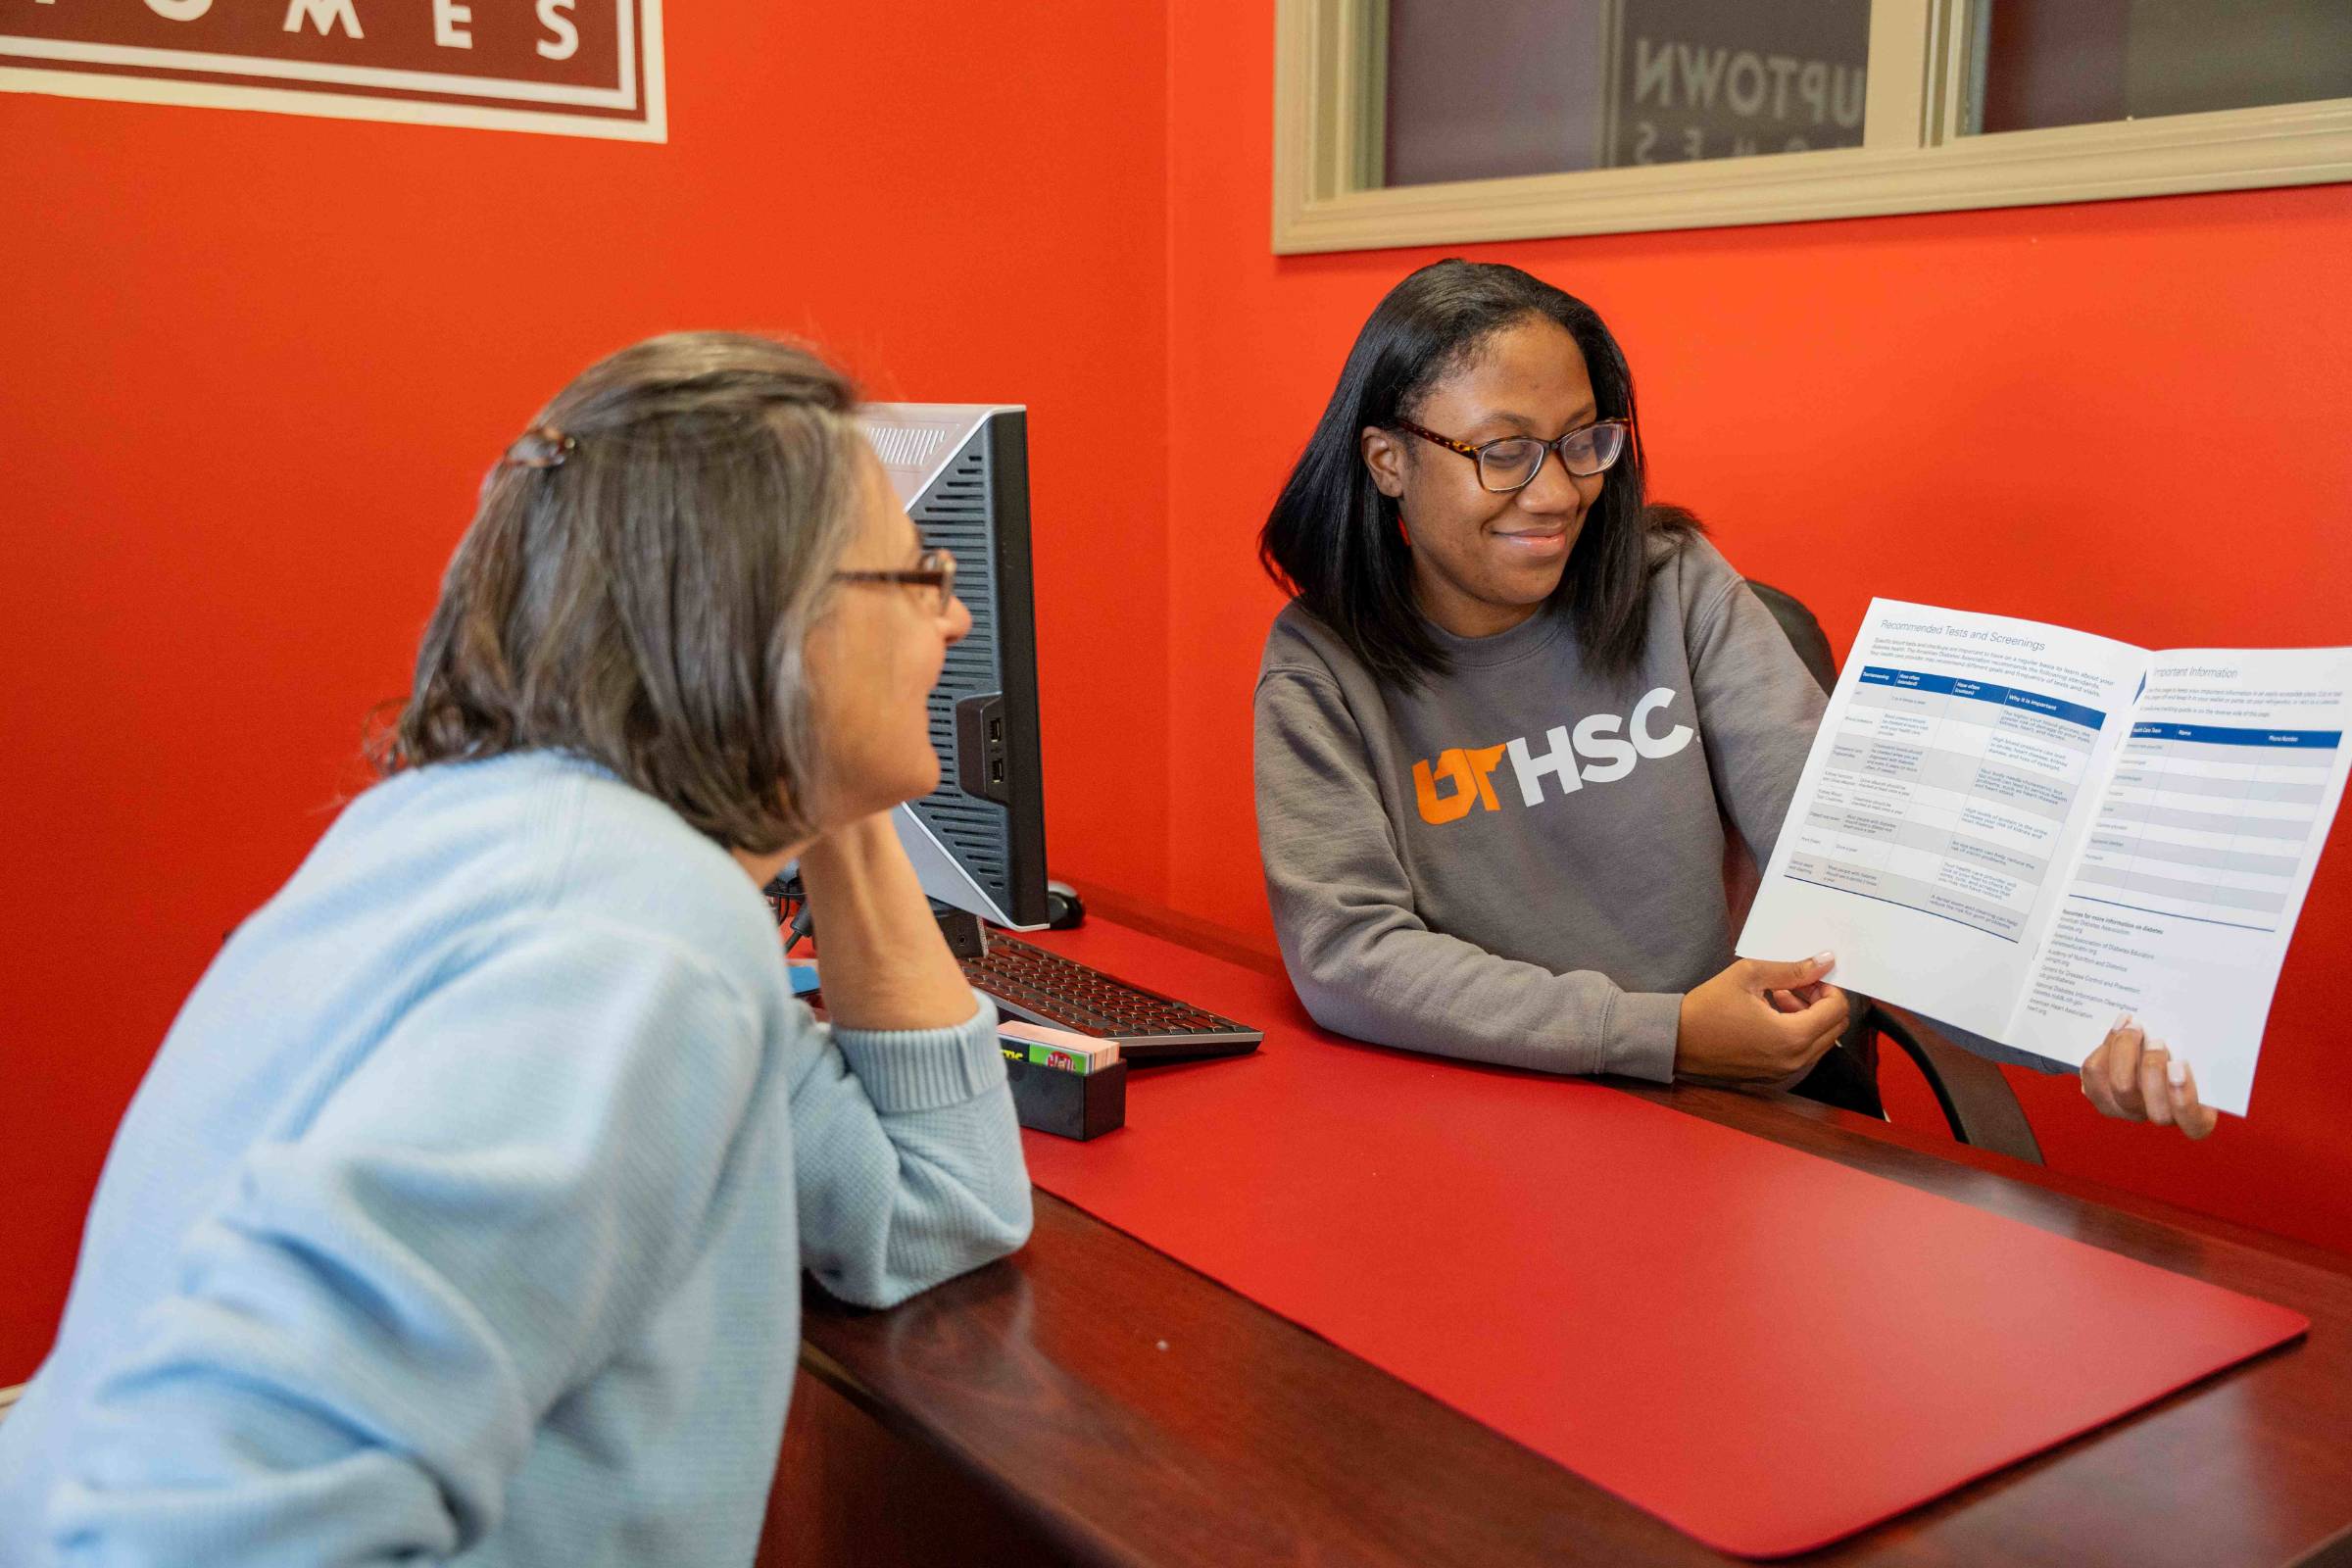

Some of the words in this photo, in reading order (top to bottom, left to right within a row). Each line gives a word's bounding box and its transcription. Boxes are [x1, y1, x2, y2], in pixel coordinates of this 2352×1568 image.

[1881, 619, 1942, 635] Recommended
[1942, 627, 1968, 638] Tests
[1969, 632, 1988, 641] and
[1989, 633, 2047, 651] Screenings
[2189, 667, 2240, 677] Information
[2030, 700, 2058, 711] important
[2105, 917, 2135, 928] information
[2142, 925, 2164, 934] diabetes
[2108, 944, 2131, 954] Diabetes
[2053, 985, 2074, 995] Diabetes
